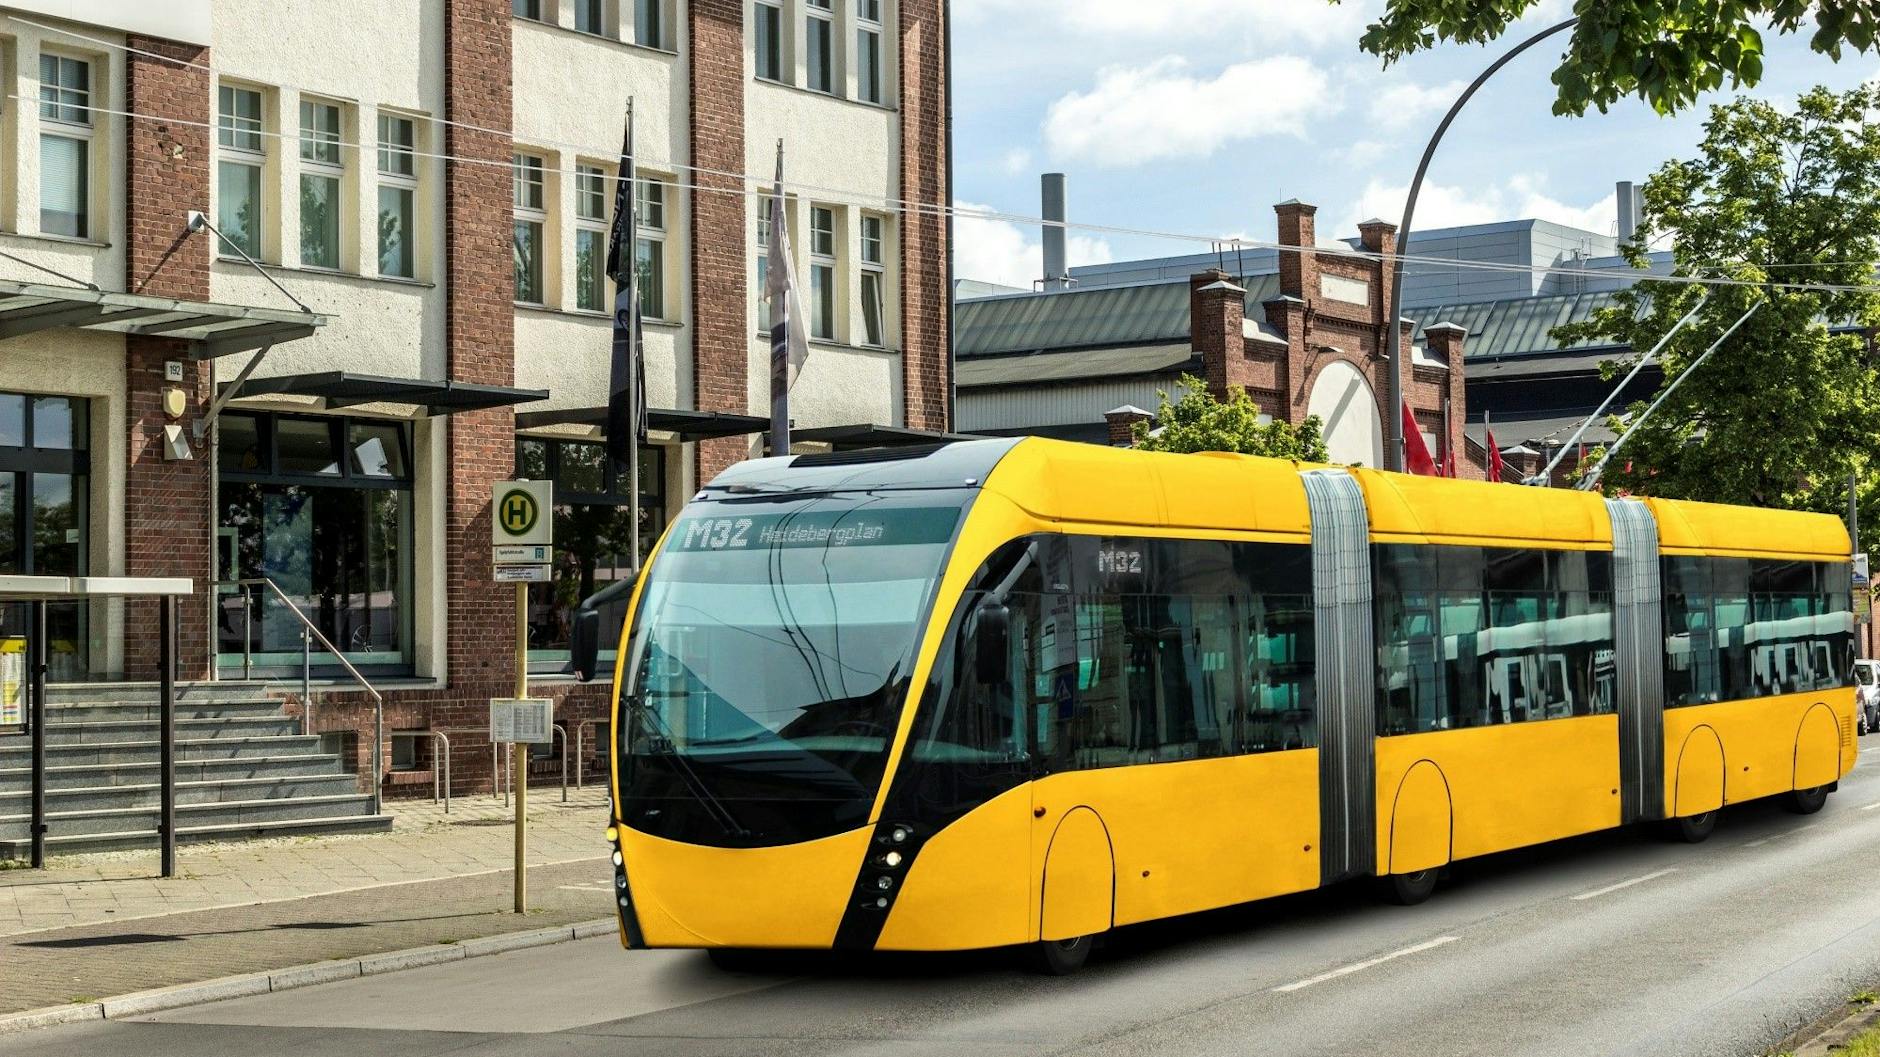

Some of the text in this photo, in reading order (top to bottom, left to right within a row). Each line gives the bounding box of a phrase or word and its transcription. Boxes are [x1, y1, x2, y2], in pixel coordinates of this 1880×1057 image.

[169, 365, 181, 375] 192
[508, 500, 526, 525] H
[683, 518, 753, 548] M32
[1098, 550, 1142, 574] M32
